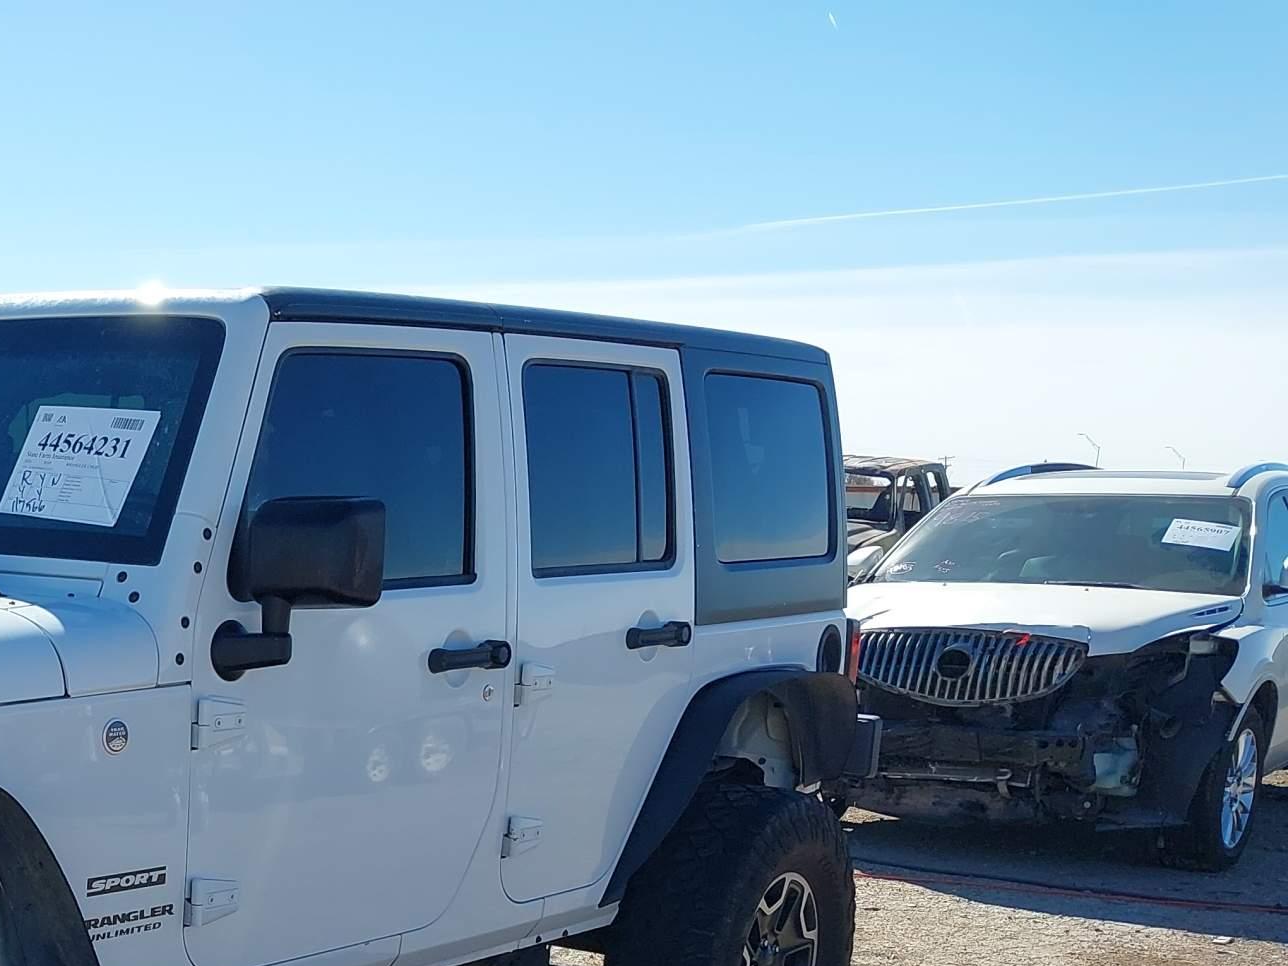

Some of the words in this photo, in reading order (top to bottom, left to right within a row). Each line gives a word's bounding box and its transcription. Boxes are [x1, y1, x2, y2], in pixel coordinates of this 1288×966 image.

[38, 432, 132, 459] 44564231
[21, 469, 32, 486] R
[87, 869, 166, 894] SPORT
